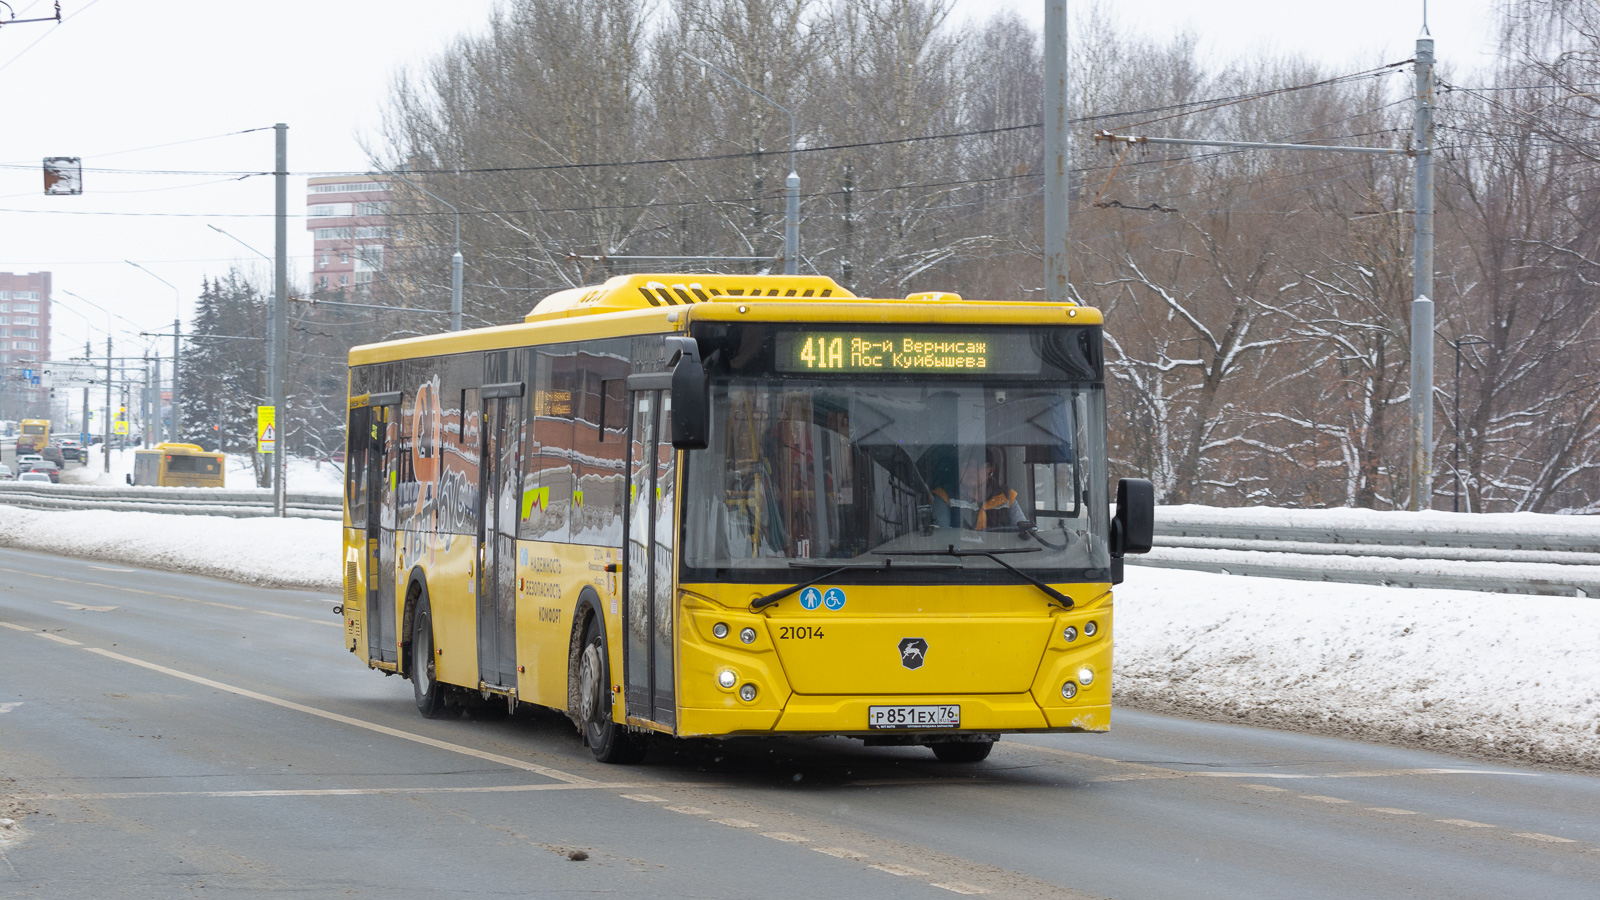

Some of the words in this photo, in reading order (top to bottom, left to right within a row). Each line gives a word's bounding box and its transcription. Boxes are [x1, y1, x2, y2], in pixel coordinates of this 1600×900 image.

[800, 337, 843, 368] 41А
[851, 338, 893, 354] Яр-й
[903, 338, 986, 354] Вернисаж
[851, 353, 883, 367] Пос
[893, 353, 986, 369] Куйбышева
[526, 580, 561, 599] БЕЗОПАСНОСТЬ
[539, 606, 561, 624] КОМФОРТ
[779, 626, 825, 640] 21014
[940, 707, 955, 719] 76
